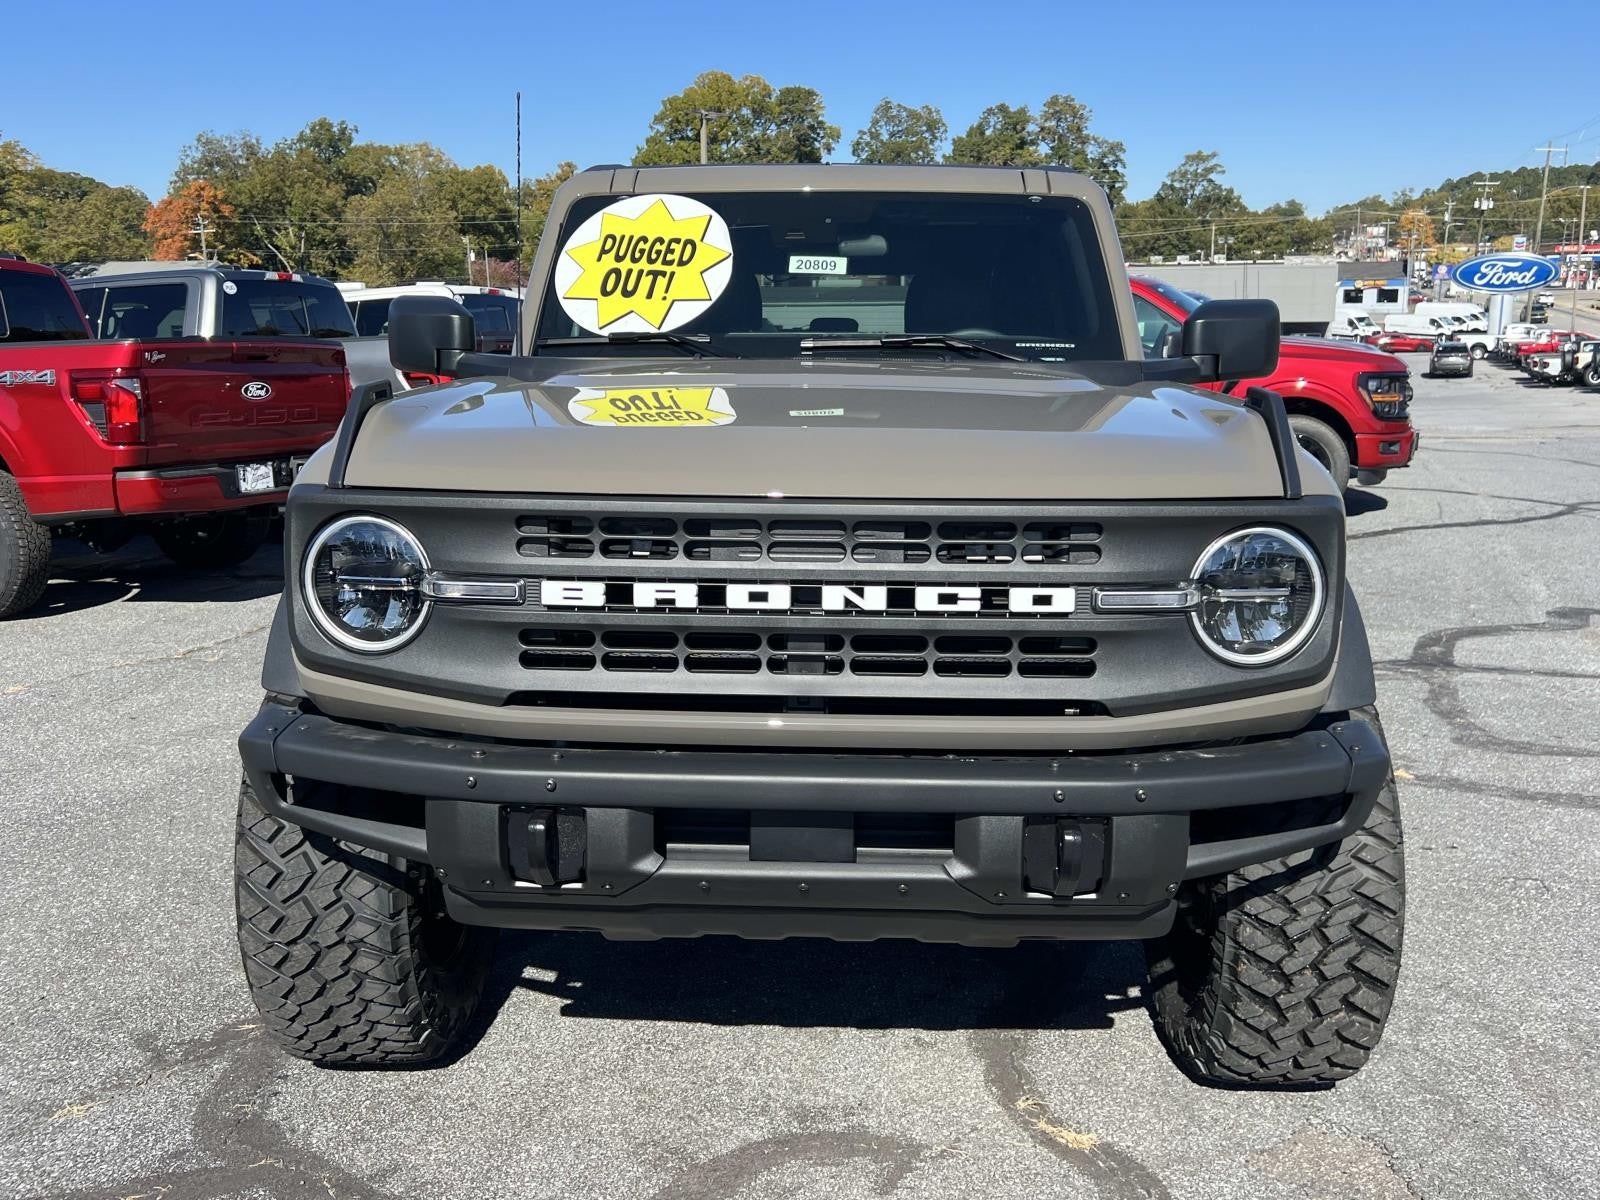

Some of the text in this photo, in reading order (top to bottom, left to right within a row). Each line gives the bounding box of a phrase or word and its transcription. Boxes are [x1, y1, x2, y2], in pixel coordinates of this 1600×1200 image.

[596, 233, 697, 267] PUGGED
[795, 259, 837, 271] 20809
[1474, 261, 1538, 286] Ford
[600, 267, 676, 301] OUT!
[246, 384, 267, 397] Ford
[189, 406, 318, 428] F-150
[540, 580, 1076, 615] BRONCO
